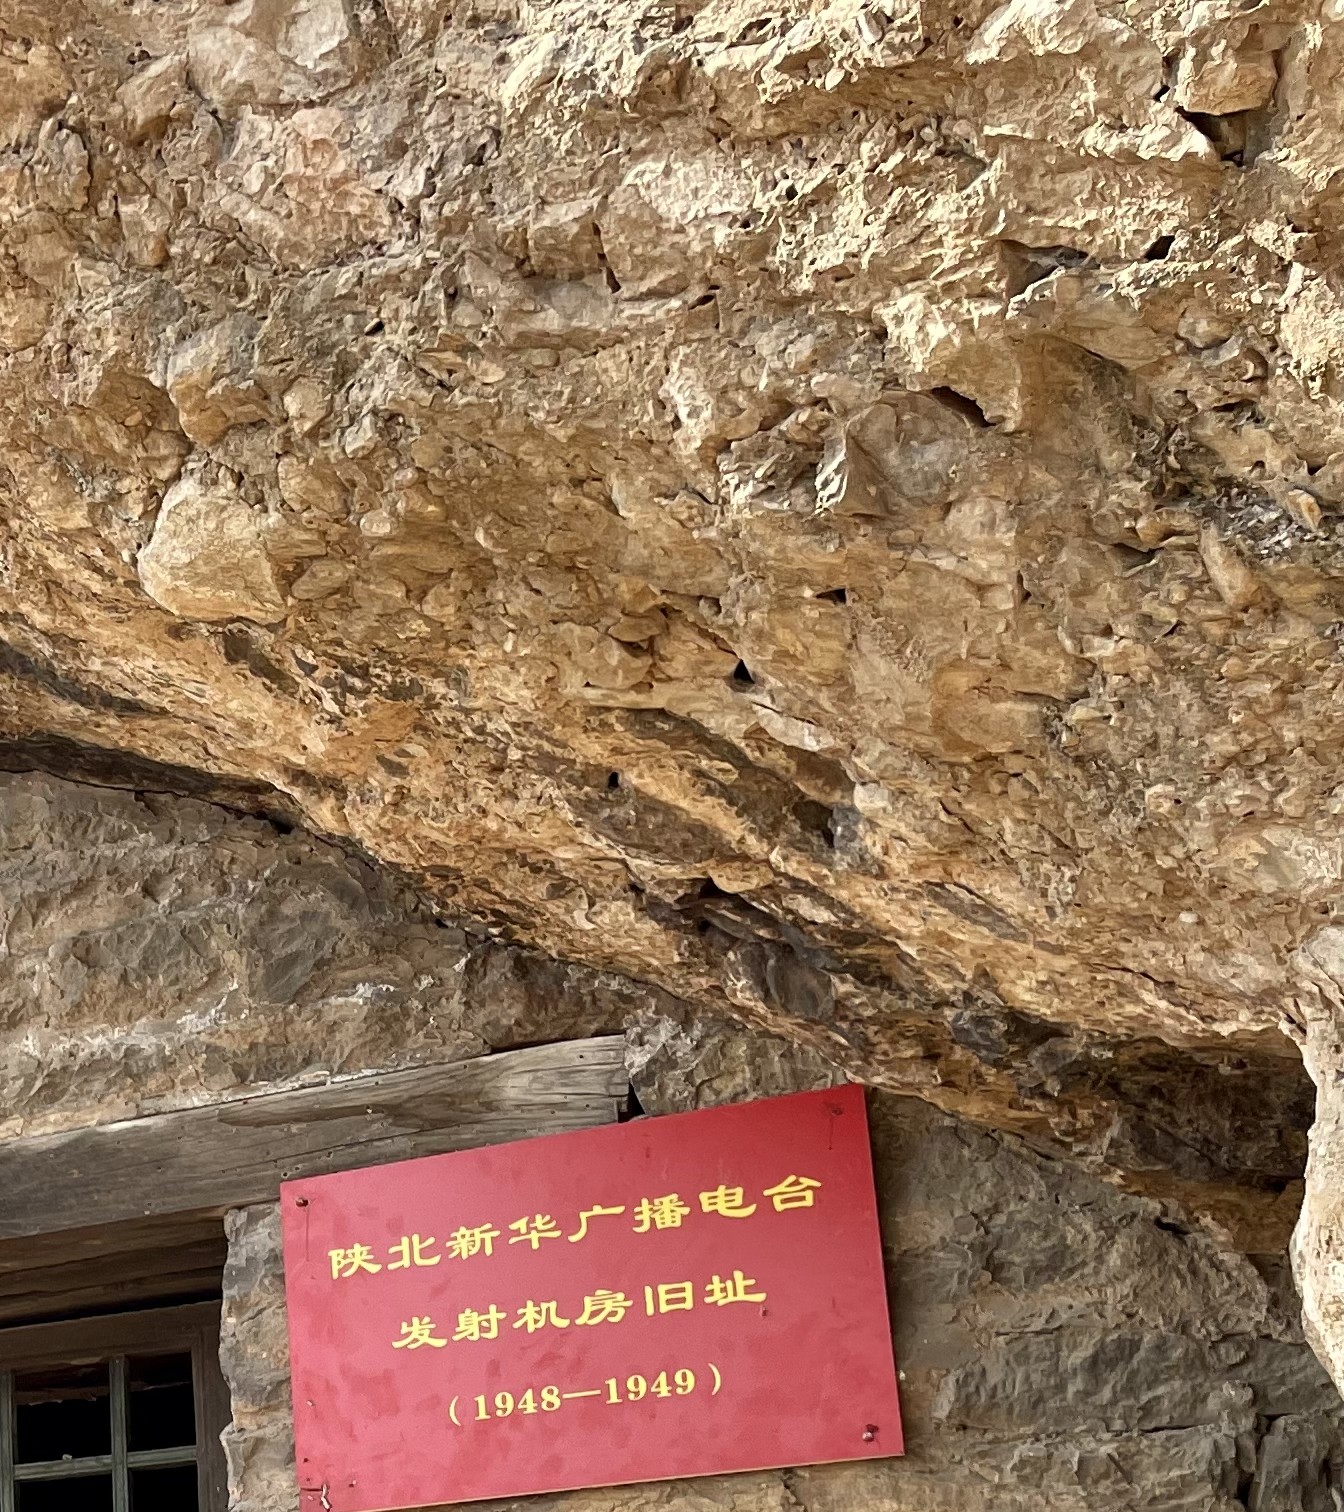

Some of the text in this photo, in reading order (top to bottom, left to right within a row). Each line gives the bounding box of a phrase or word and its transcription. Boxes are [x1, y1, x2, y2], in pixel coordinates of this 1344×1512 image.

[328, 1174, 822, 1280] 陕北新华广播电台
[391, 1269, 768, 1351] 发射机房旧址
